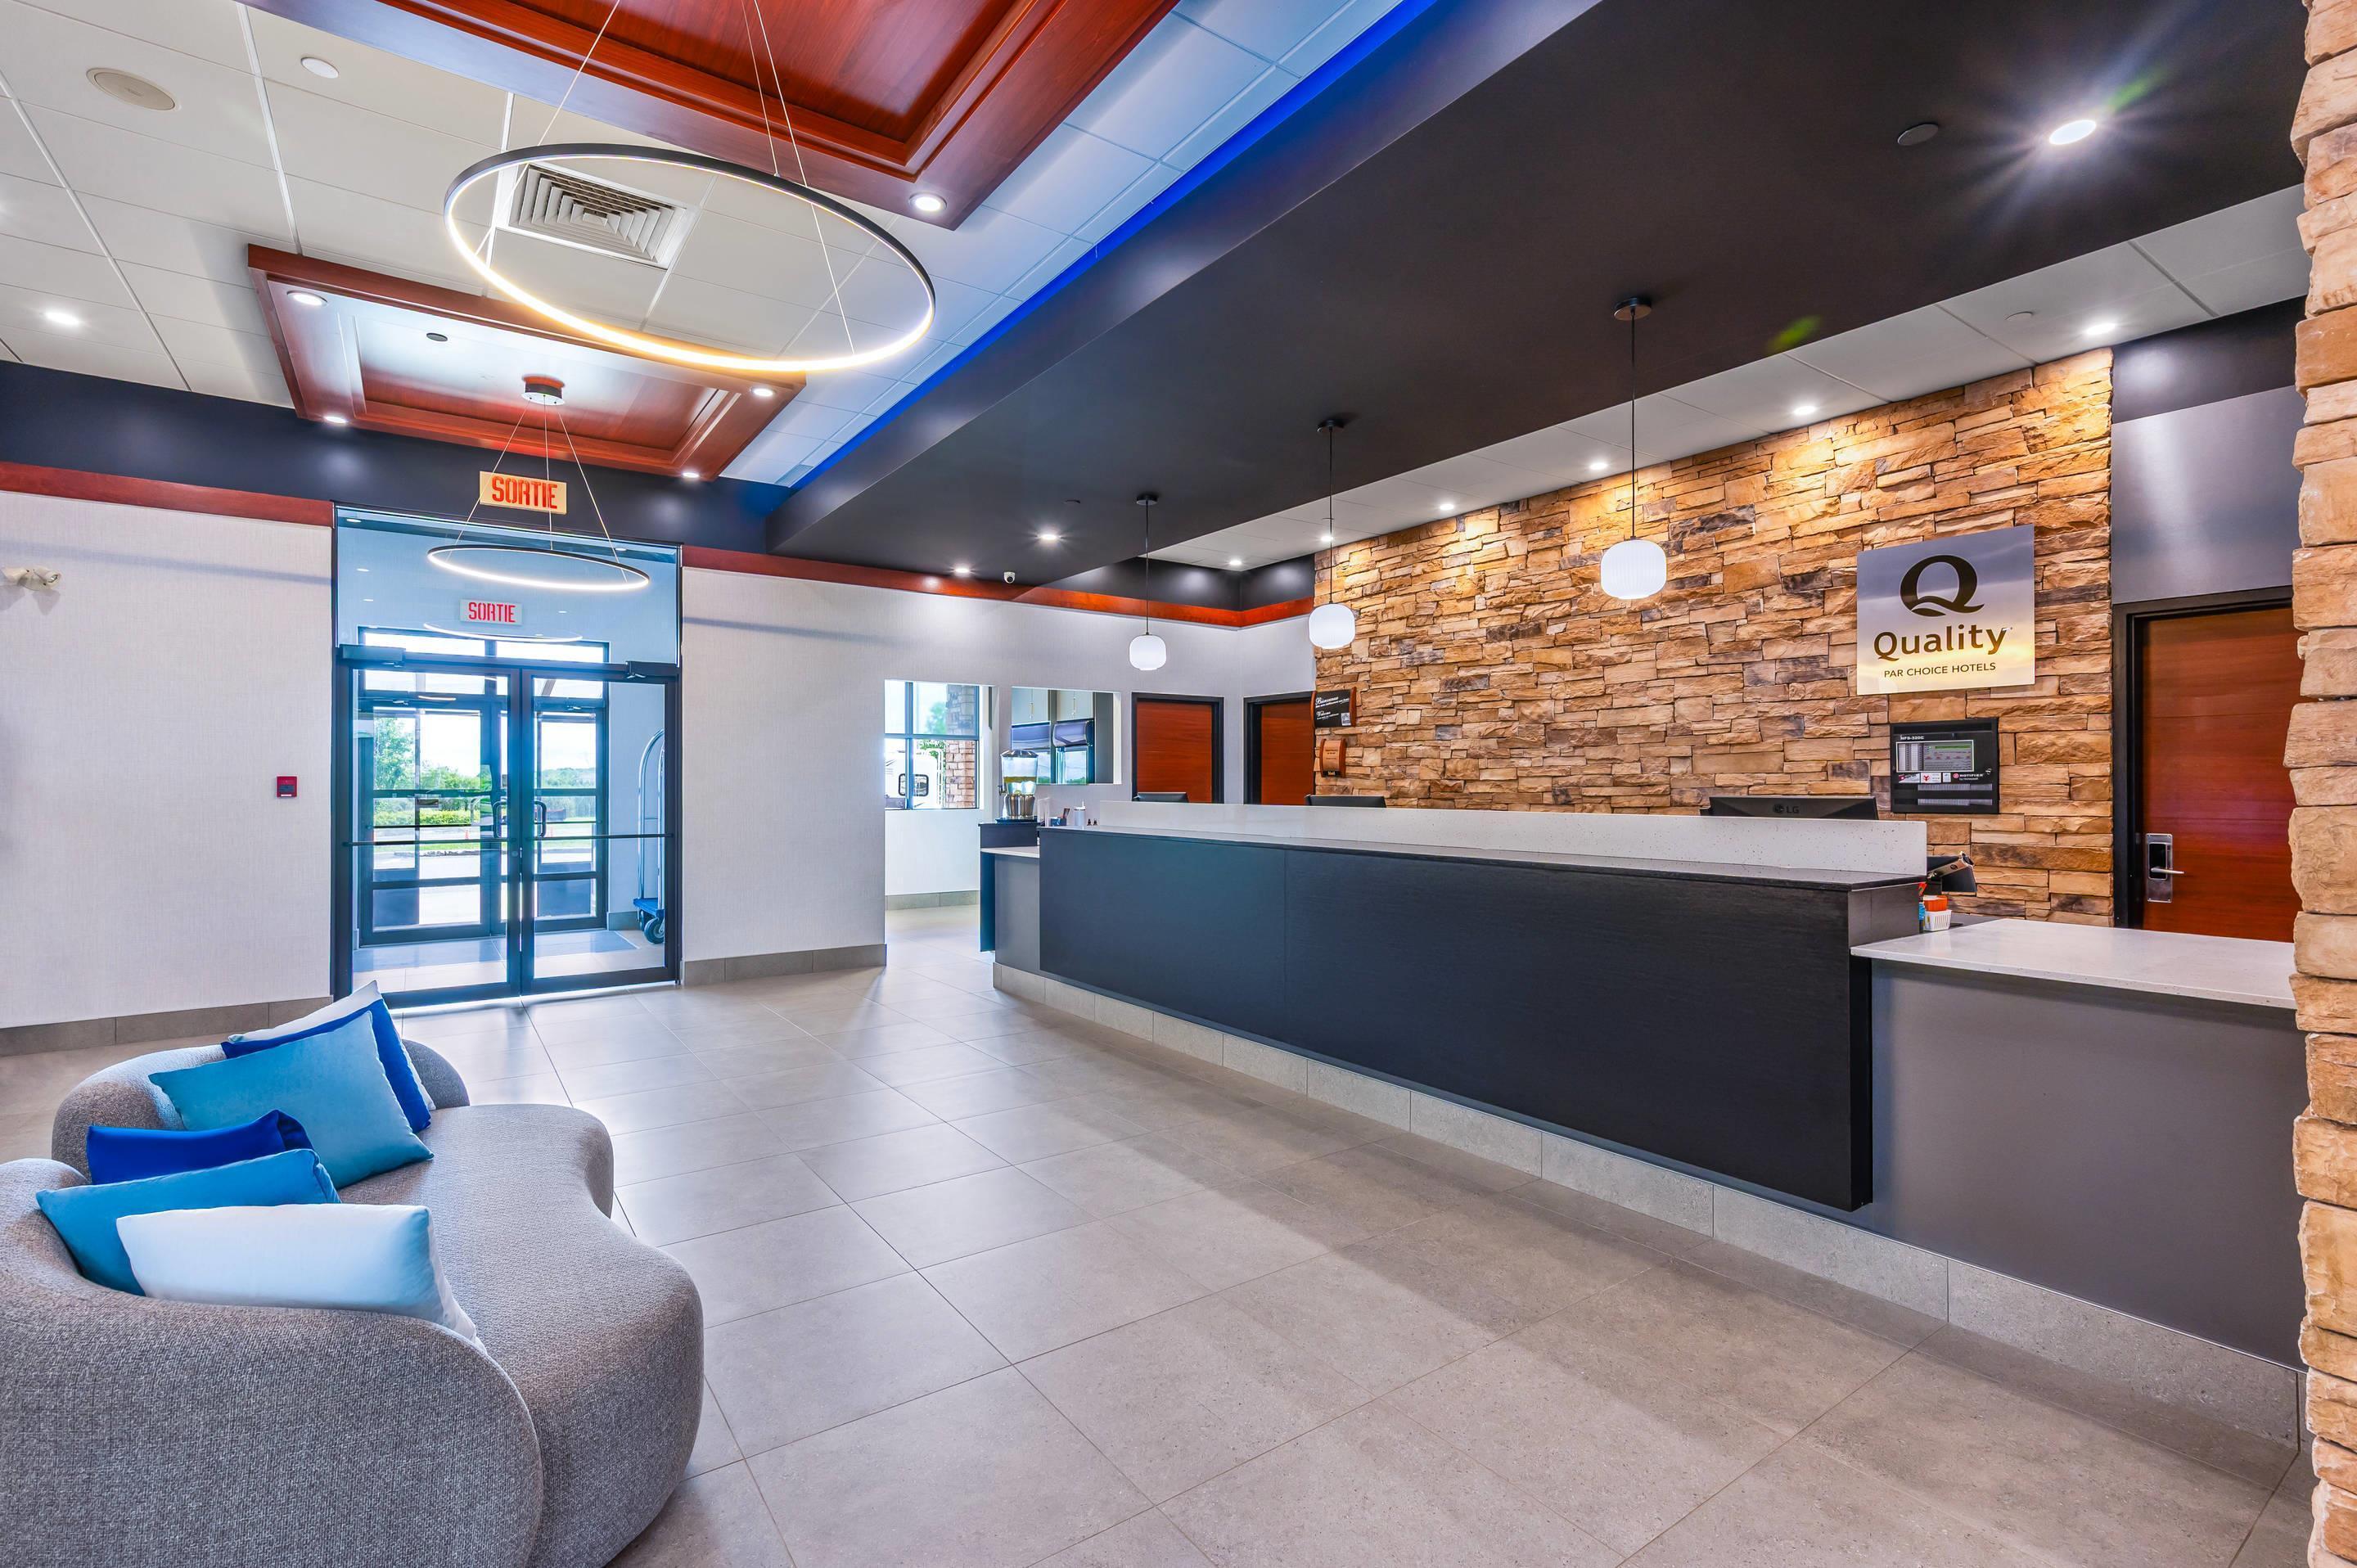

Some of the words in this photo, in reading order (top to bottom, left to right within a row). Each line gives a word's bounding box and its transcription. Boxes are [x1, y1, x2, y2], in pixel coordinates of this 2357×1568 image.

[491, 475, 558, 509] SORTIE
[1900, 554, 1985, 617] Q
[468, 602, 516, 623] SORTIE
[1873, 624, 2007, 661] Quality
[1884, 669, 1903, 678] PAR
[1906, 665, 1948, 676] CHOICE
[1951, 662, 1996, 673] HOTELS
[1786, 805, 1799, 813] LG
